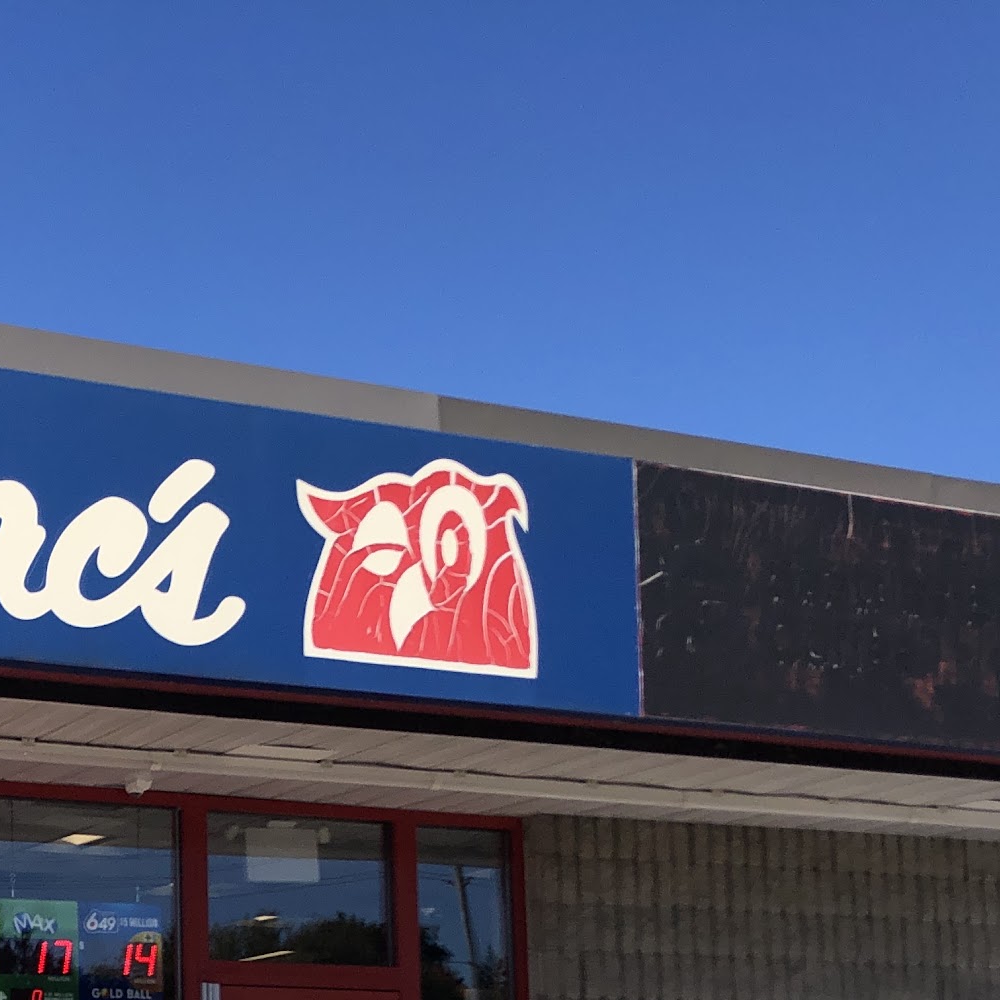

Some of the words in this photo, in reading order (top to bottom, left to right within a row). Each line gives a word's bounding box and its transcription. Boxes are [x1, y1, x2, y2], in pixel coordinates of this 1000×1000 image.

[14, 911, 57, 934] MAX
[37, 940, 74, 975] 17
[122, 943, 158, 977] 14
[127, 988, 153, 1000] BALL
